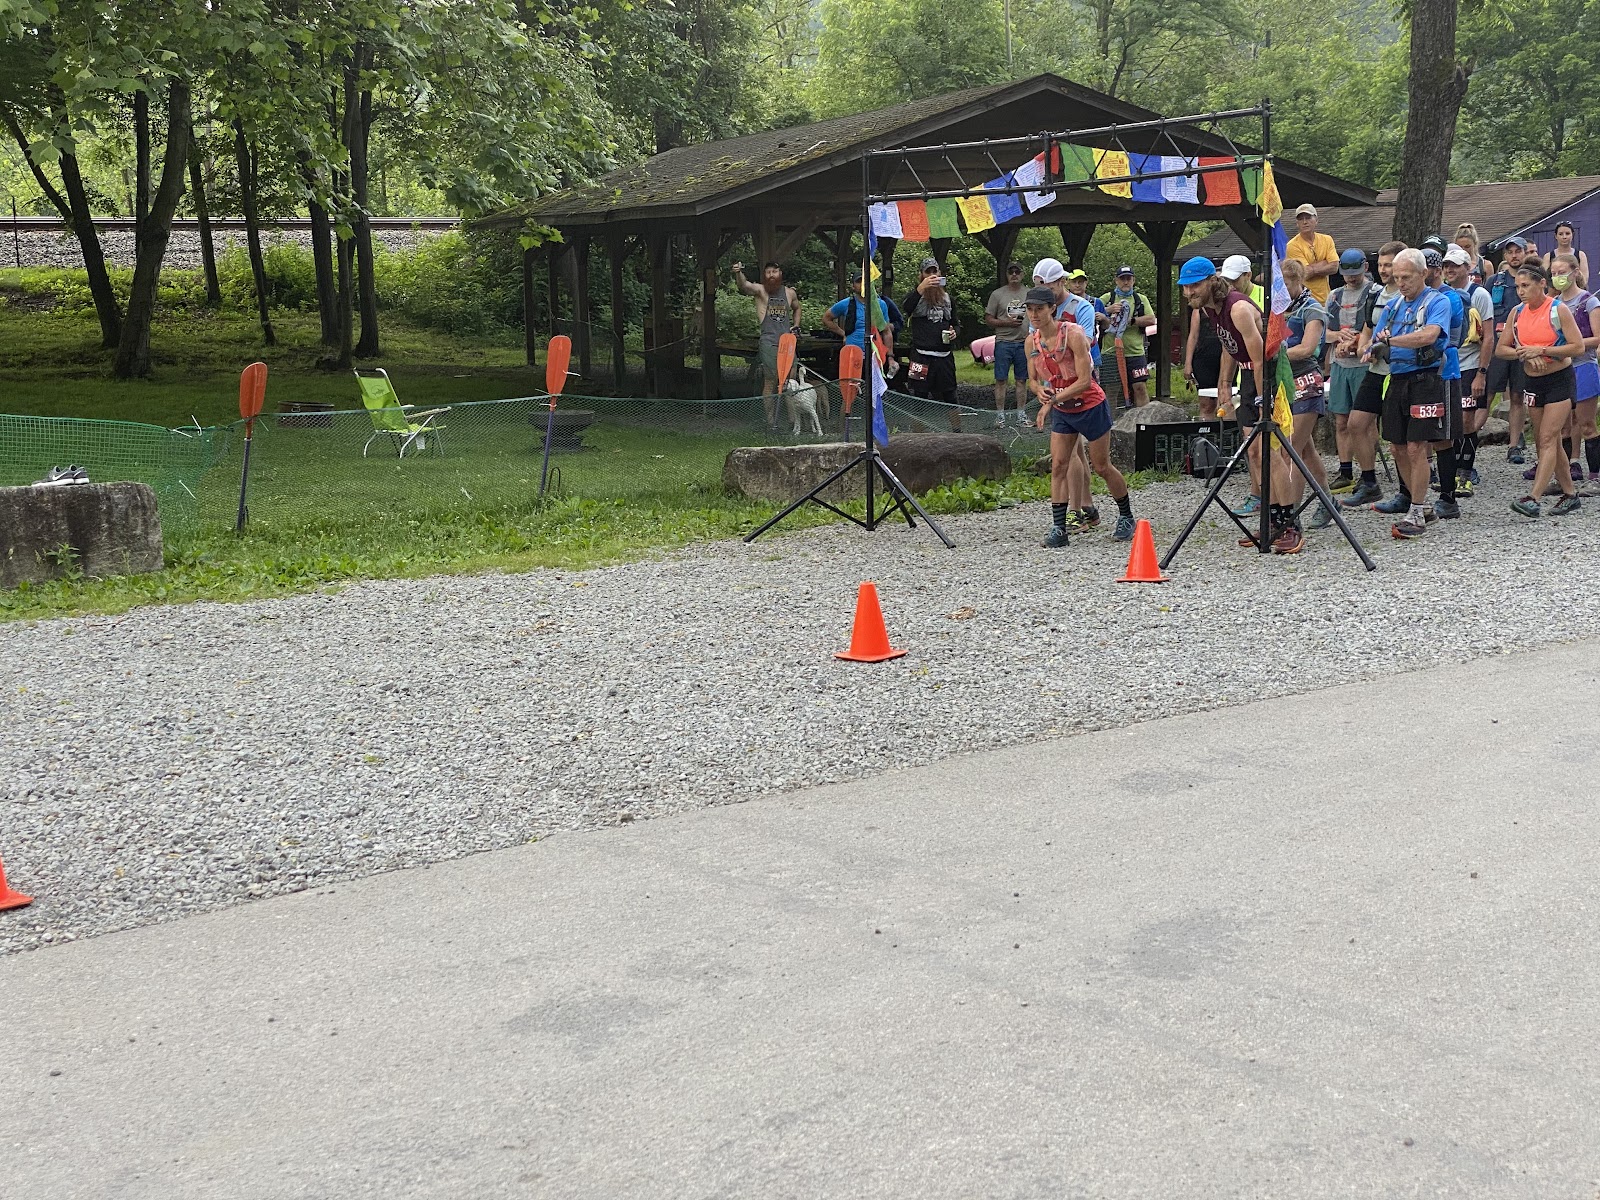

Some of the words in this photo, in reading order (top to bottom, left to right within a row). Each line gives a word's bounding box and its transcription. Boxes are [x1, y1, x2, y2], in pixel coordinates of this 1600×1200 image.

[911, 362, 923, 373] 628
[1134, 368, 1149, 378] 514
[1296, 373, 1316, 388] 515
[1419, 405, 1438, 418] 532
[1198, 426, 1211, 434] GILL
